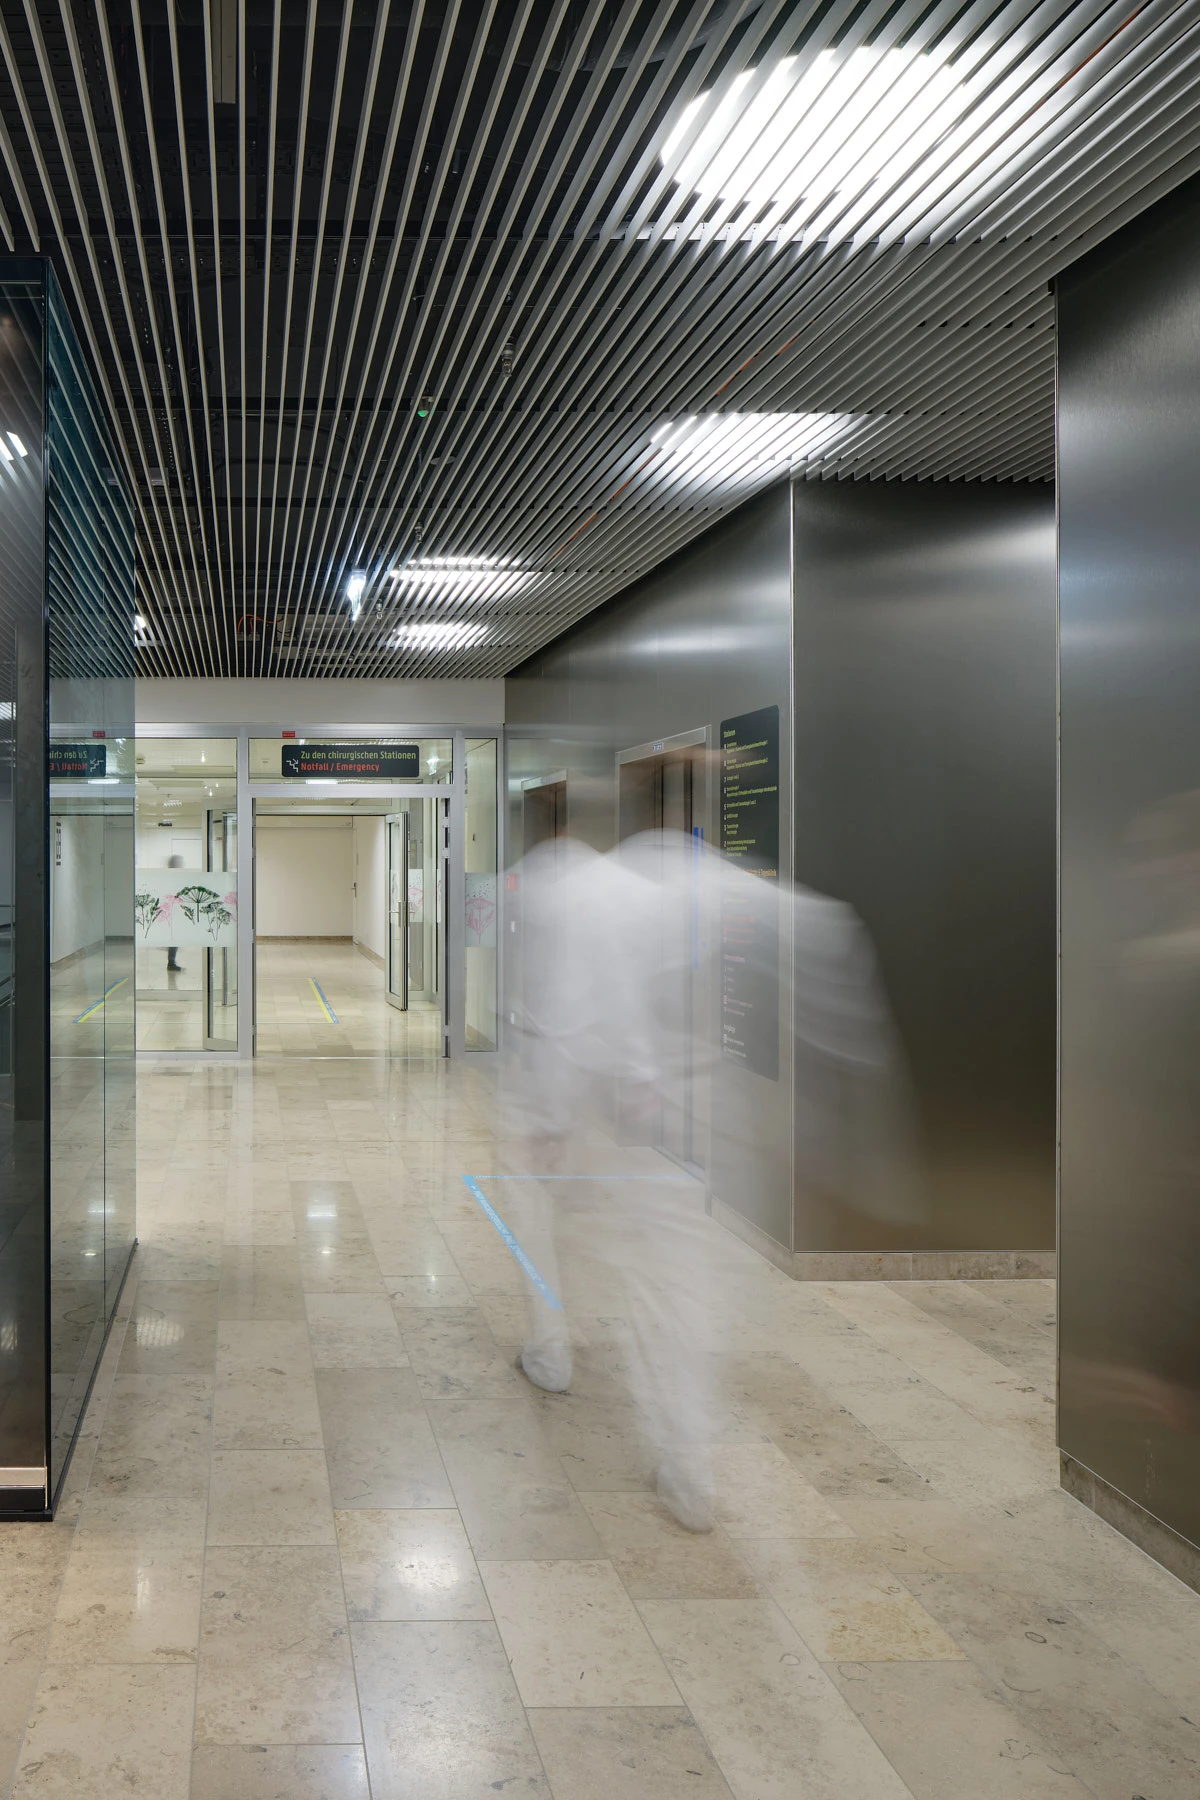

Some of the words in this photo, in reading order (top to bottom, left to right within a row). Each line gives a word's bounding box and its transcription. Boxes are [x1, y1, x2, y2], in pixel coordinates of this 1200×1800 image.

[301, 751, 311, 759] Zu
[312, 750, 326, 759] den
[328, 750, 378, 761] chirurgischen
[380, 750, 417, 759] Stationen
[301, 762, 329, 771] Notfall
[330, 762, 335, 772] /
[336, 762, 380, 772] Emergency
